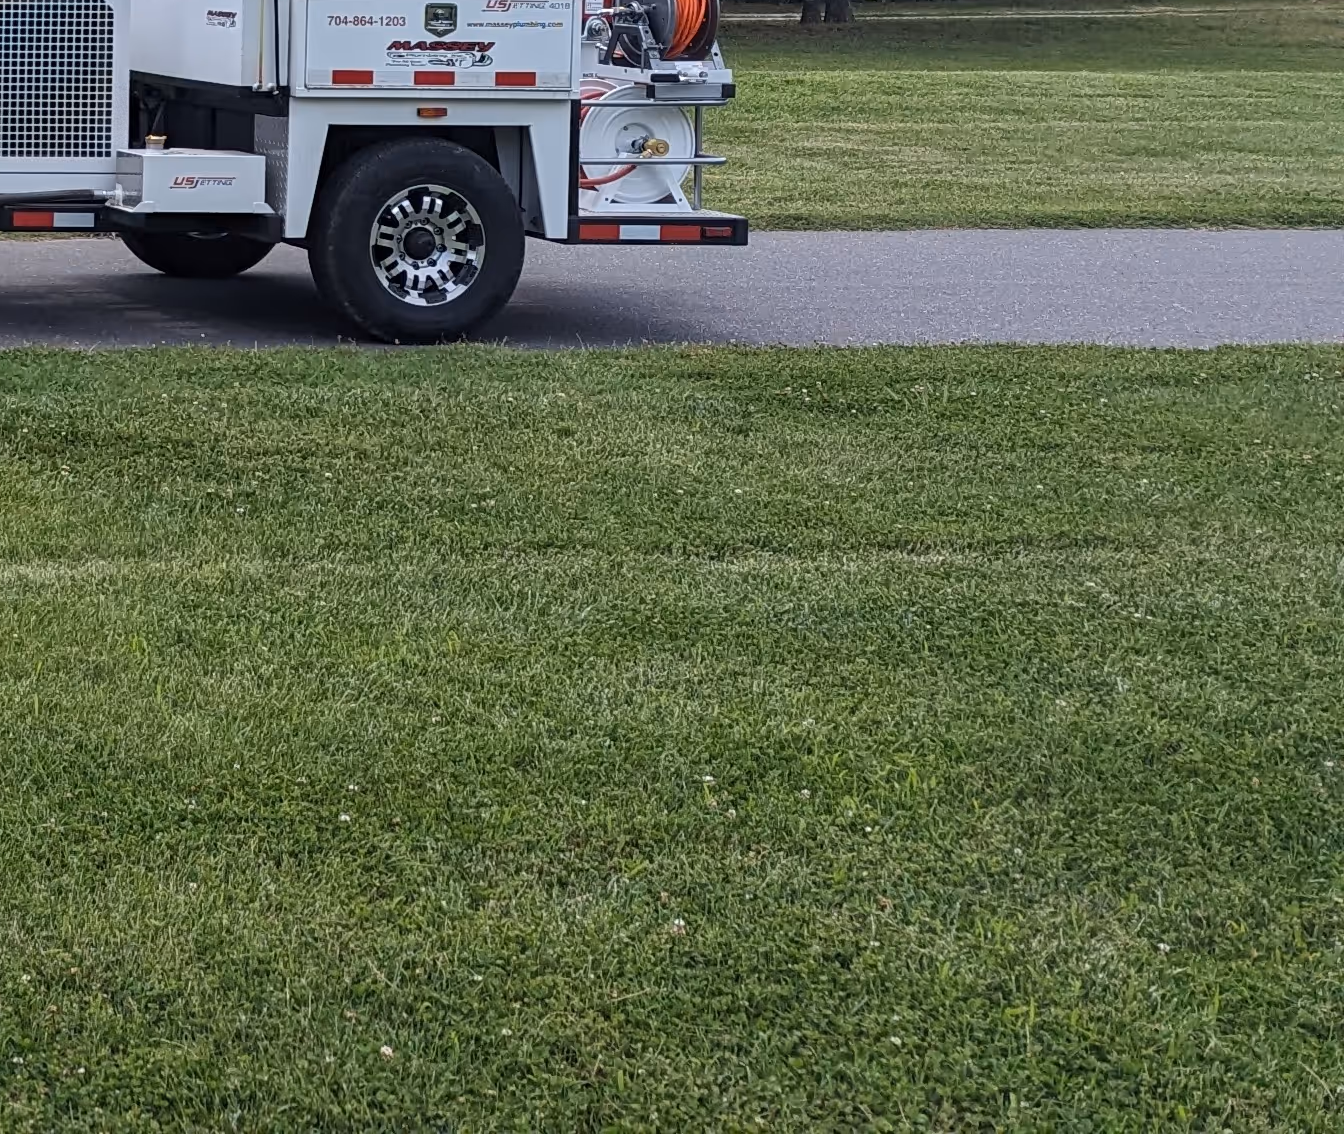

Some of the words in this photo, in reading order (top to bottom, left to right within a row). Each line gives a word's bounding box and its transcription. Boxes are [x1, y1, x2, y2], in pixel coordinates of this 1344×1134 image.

[327, 15, 407, 27] 704-864-1203
[466, 21, 564, 30] www.masseyplumbing.com
[386, 40, 496, 53] MASSEY
